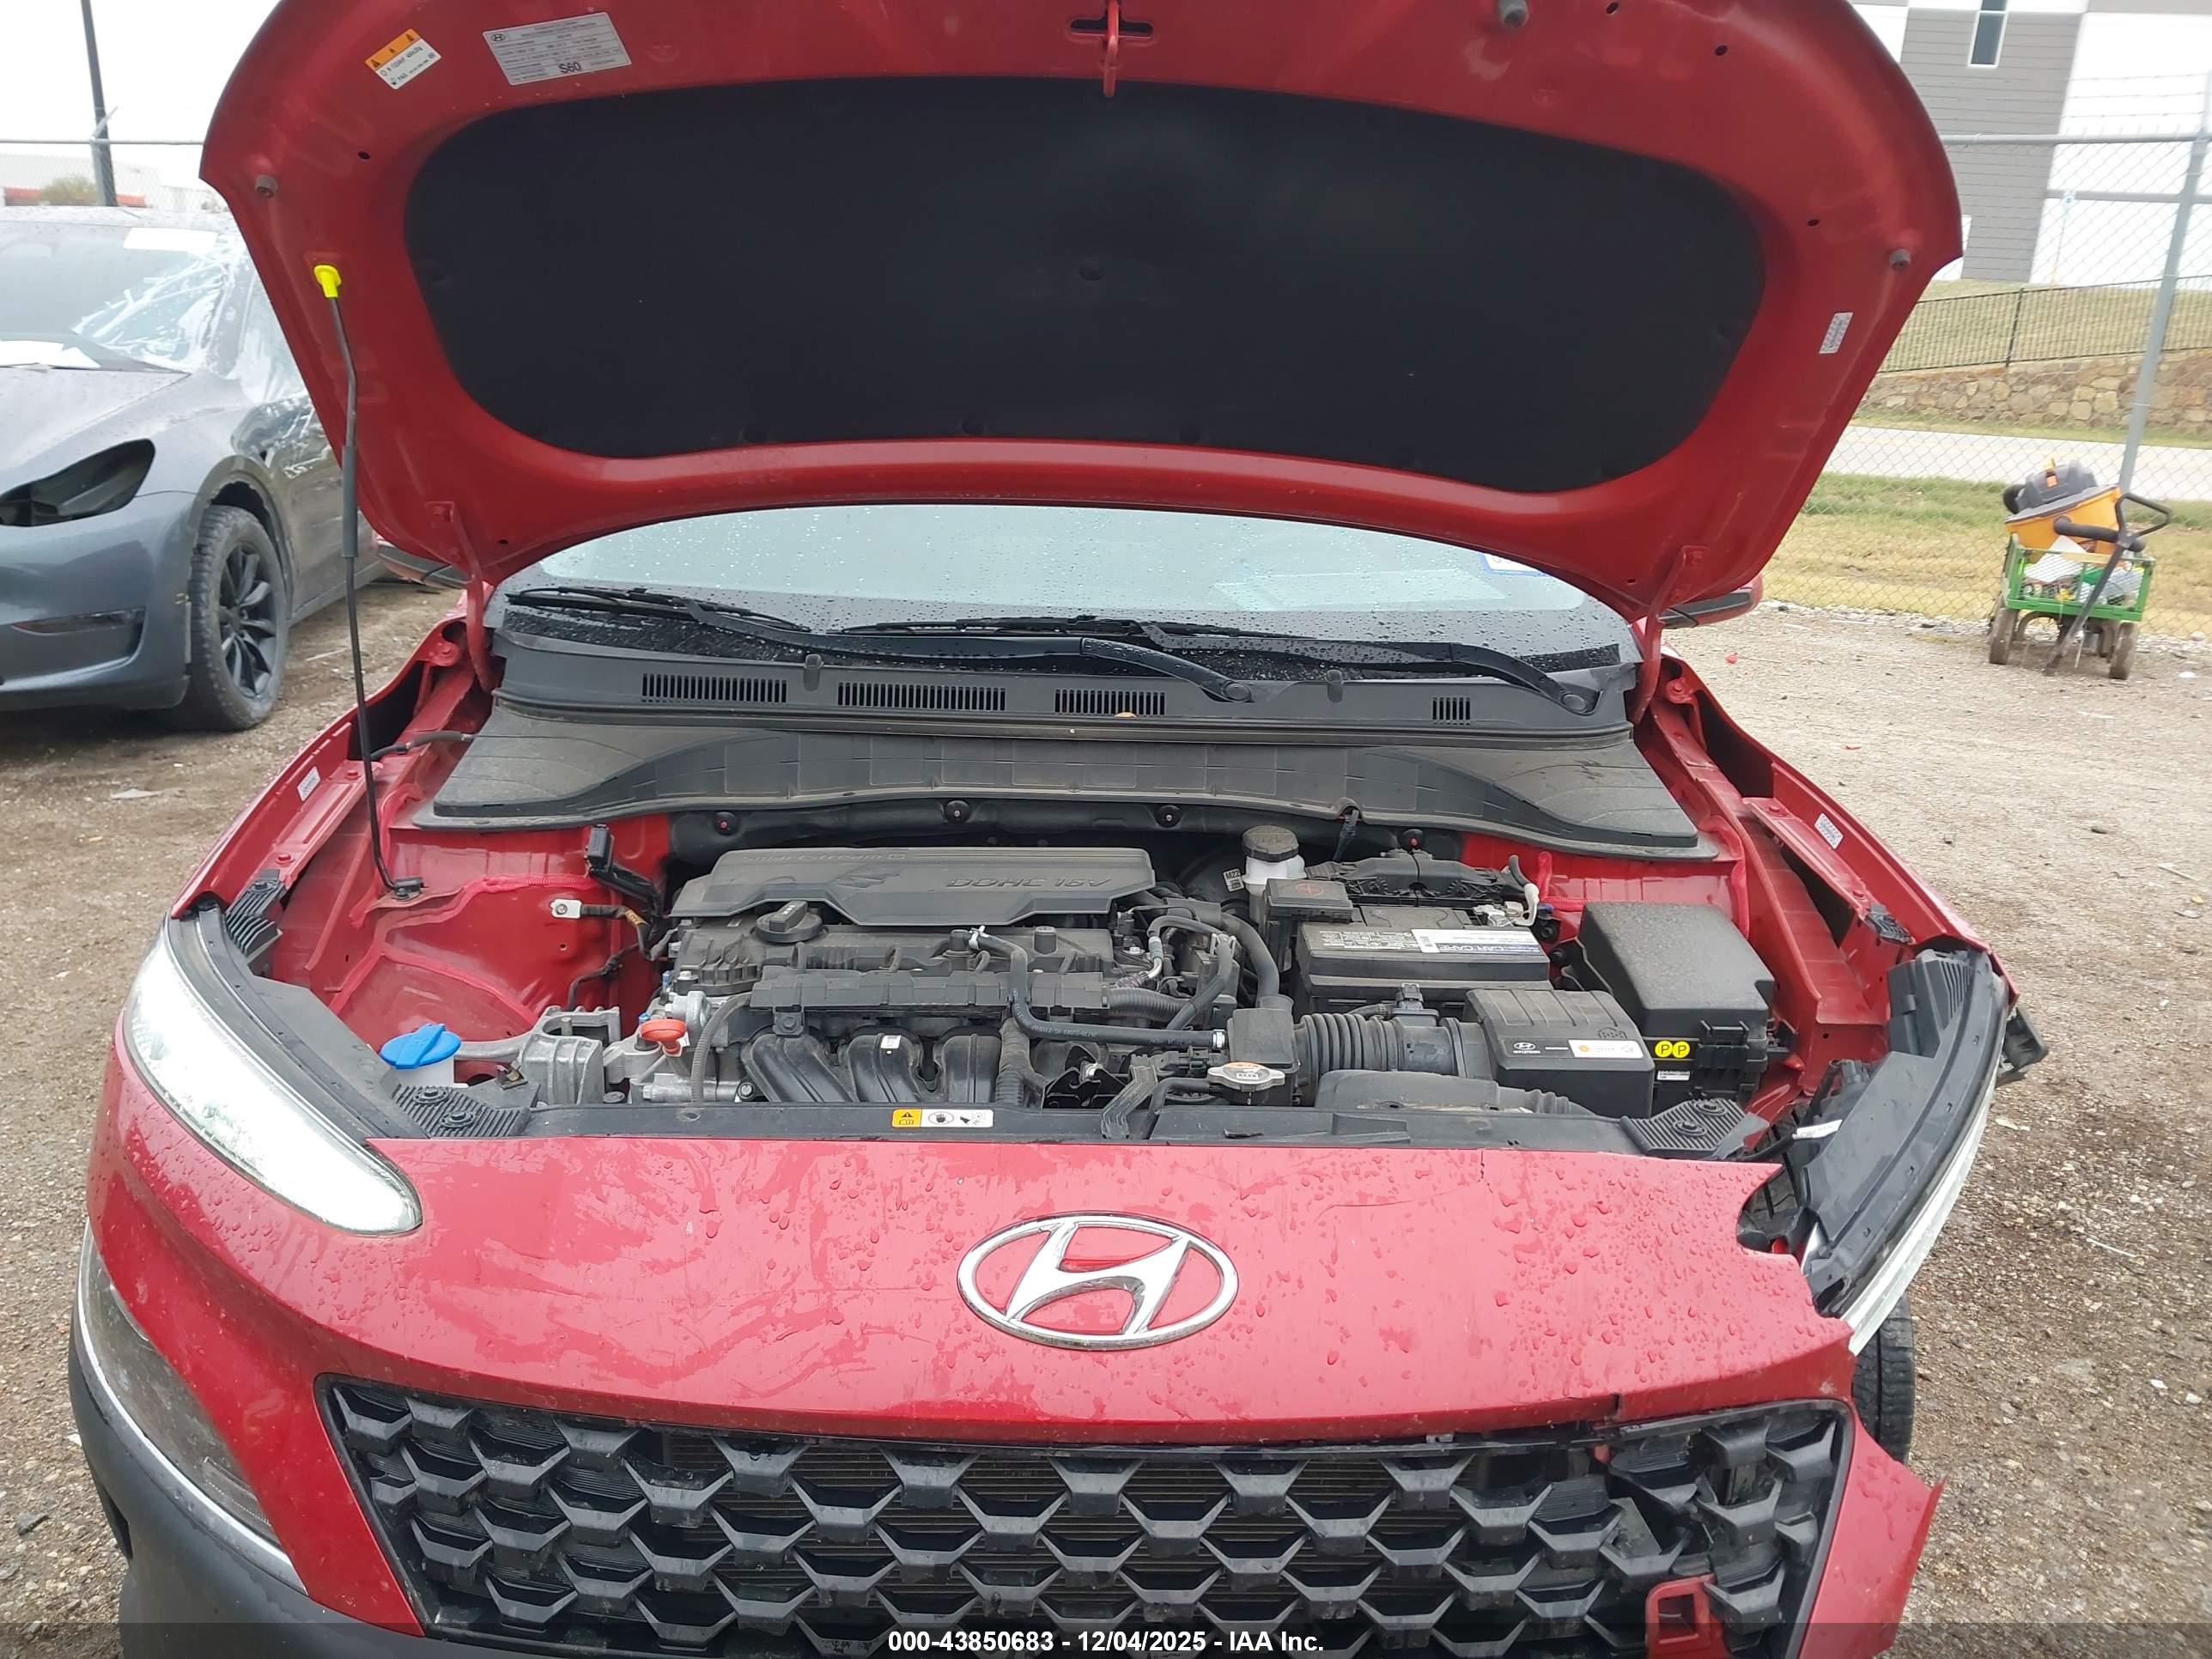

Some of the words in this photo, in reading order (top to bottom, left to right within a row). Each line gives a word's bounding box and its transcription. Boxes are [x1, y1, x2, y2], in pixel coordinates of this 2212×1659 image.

[559, 61, 581, 74] S60
[1225, 870, 1241, 880] M22
[946, 878, 1046, 888] DOHC
[1054, 878, 1112, 888] 16V
